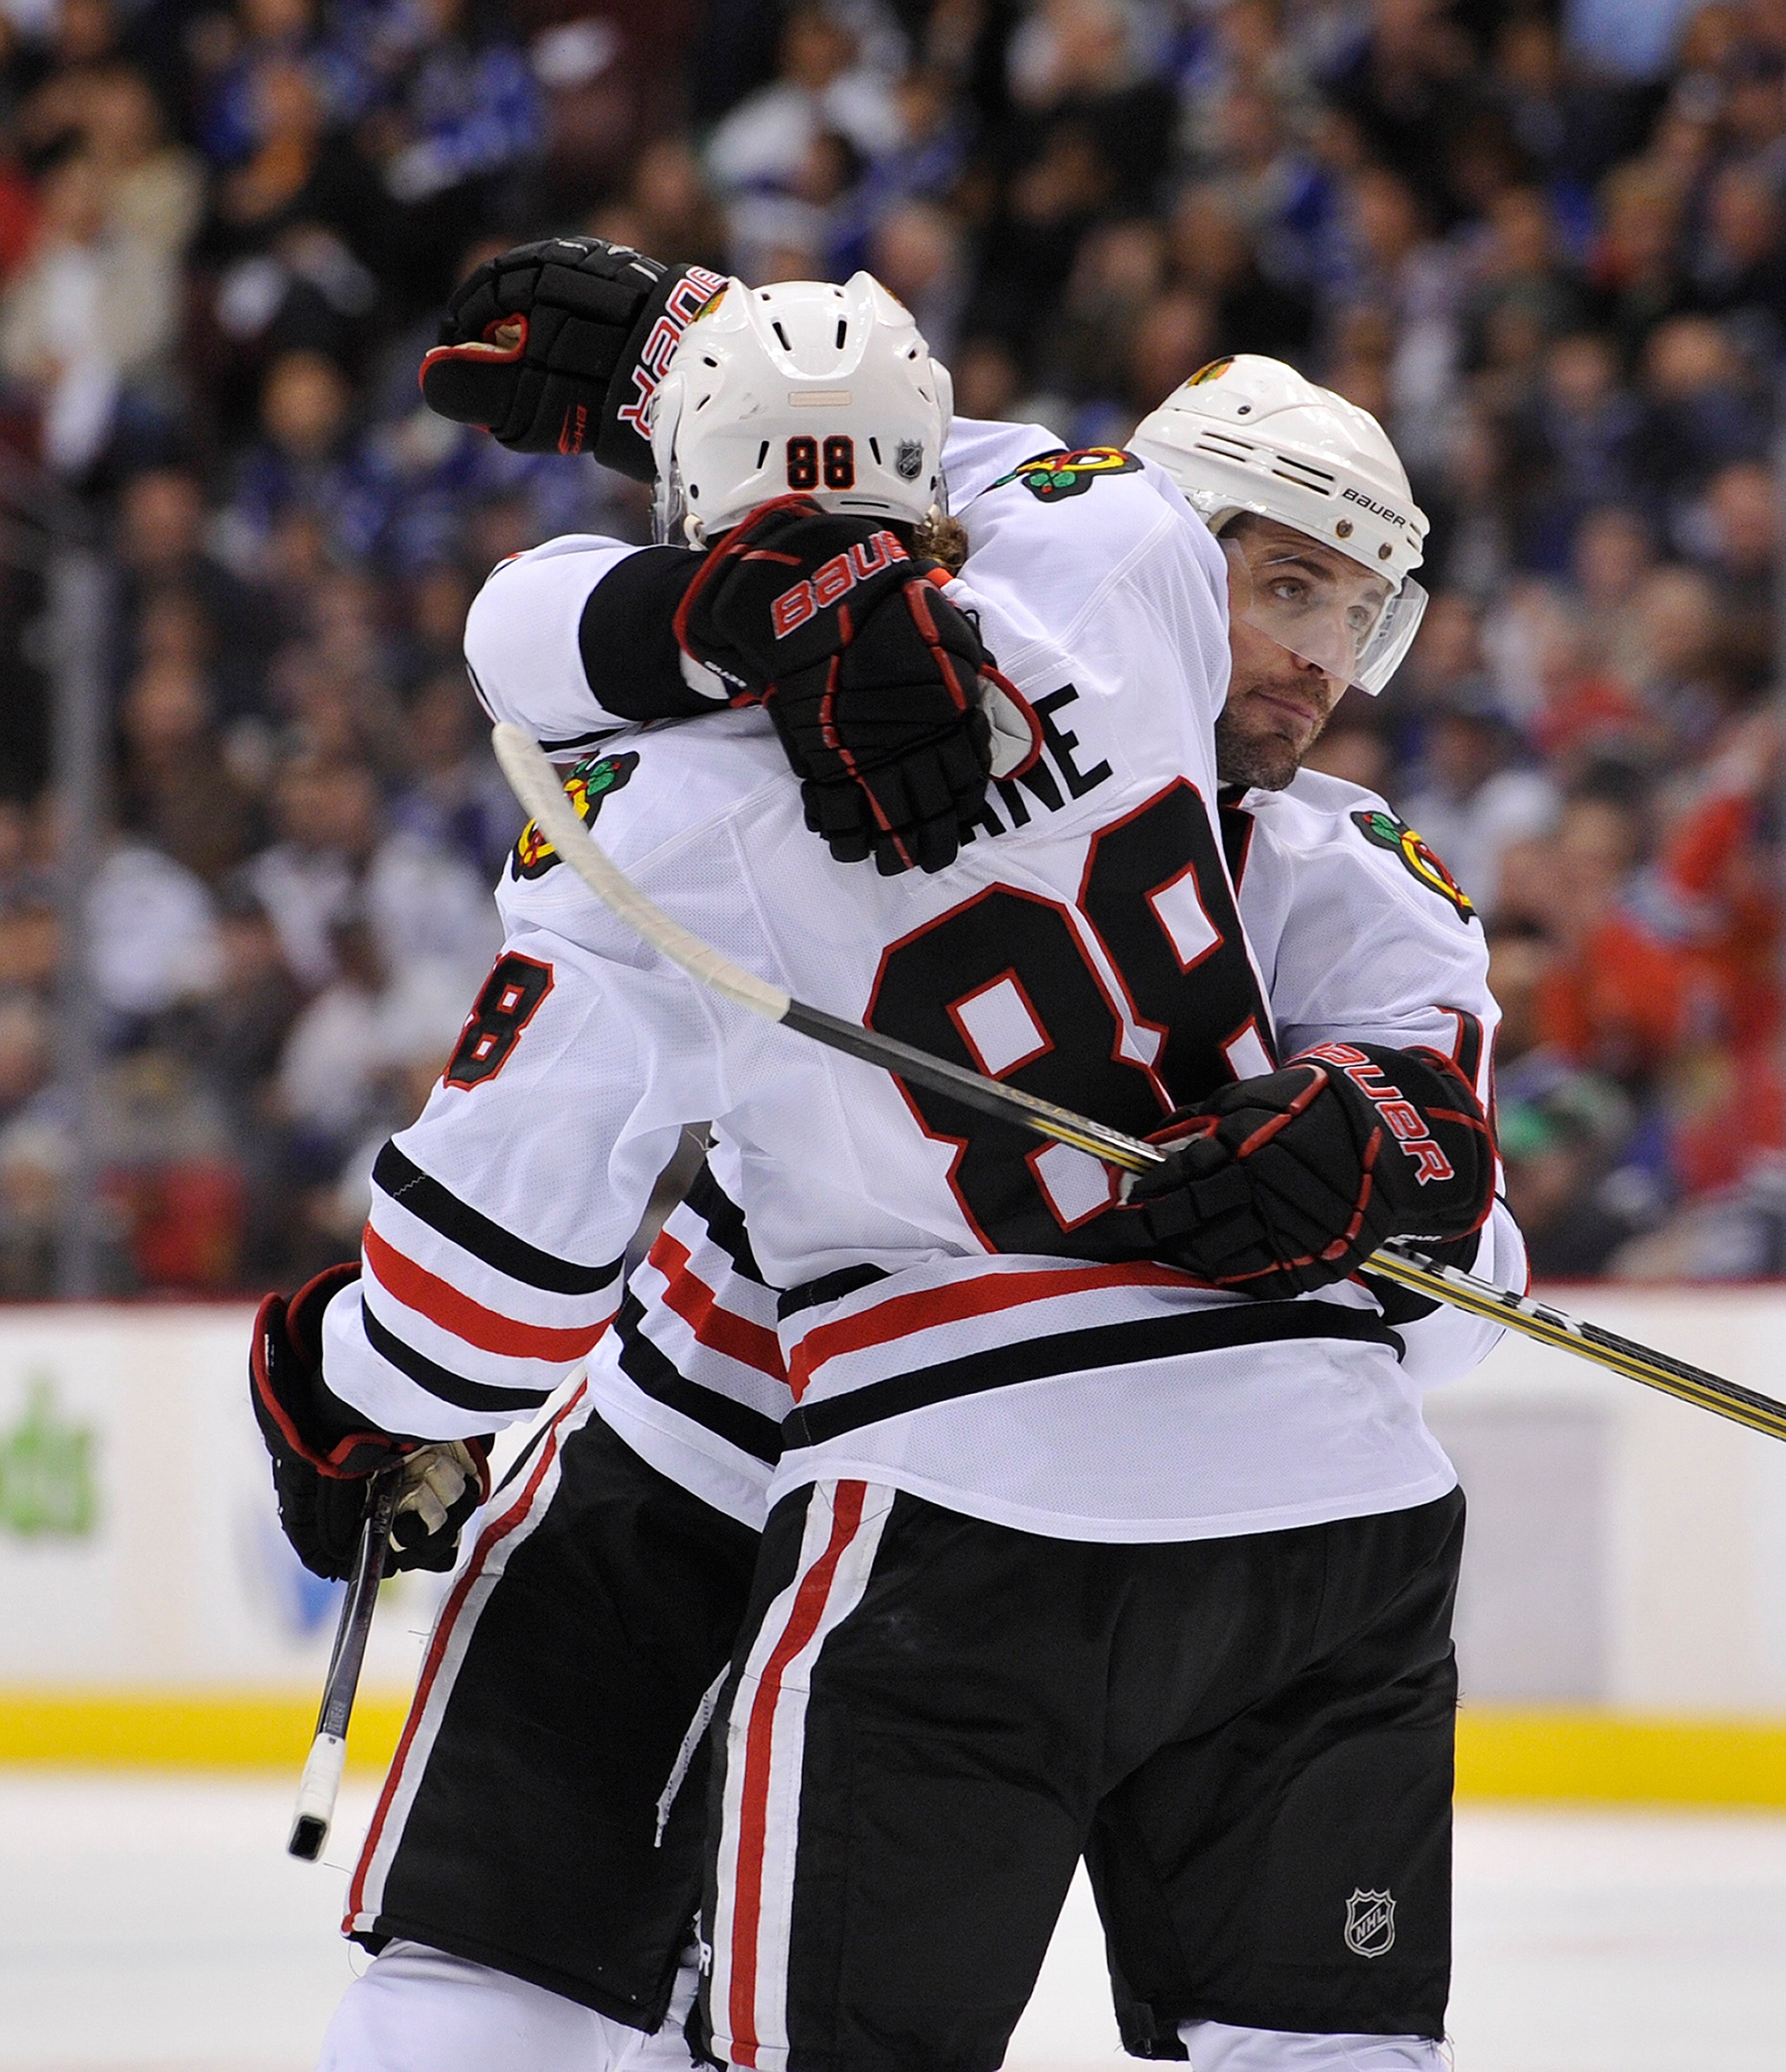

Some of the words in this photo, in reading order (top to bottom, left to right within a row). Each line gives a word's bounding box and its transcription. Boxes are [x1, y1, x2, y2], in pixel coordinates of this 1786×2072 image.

[786, 435, 856, 491] 88
[442, 949, 556, 1093] 8
[862, 775, 1279, 1255] 88
[1283, 1042, 1456, 1187] AUER
[1357, 1907, 1386, 1942] NHL
